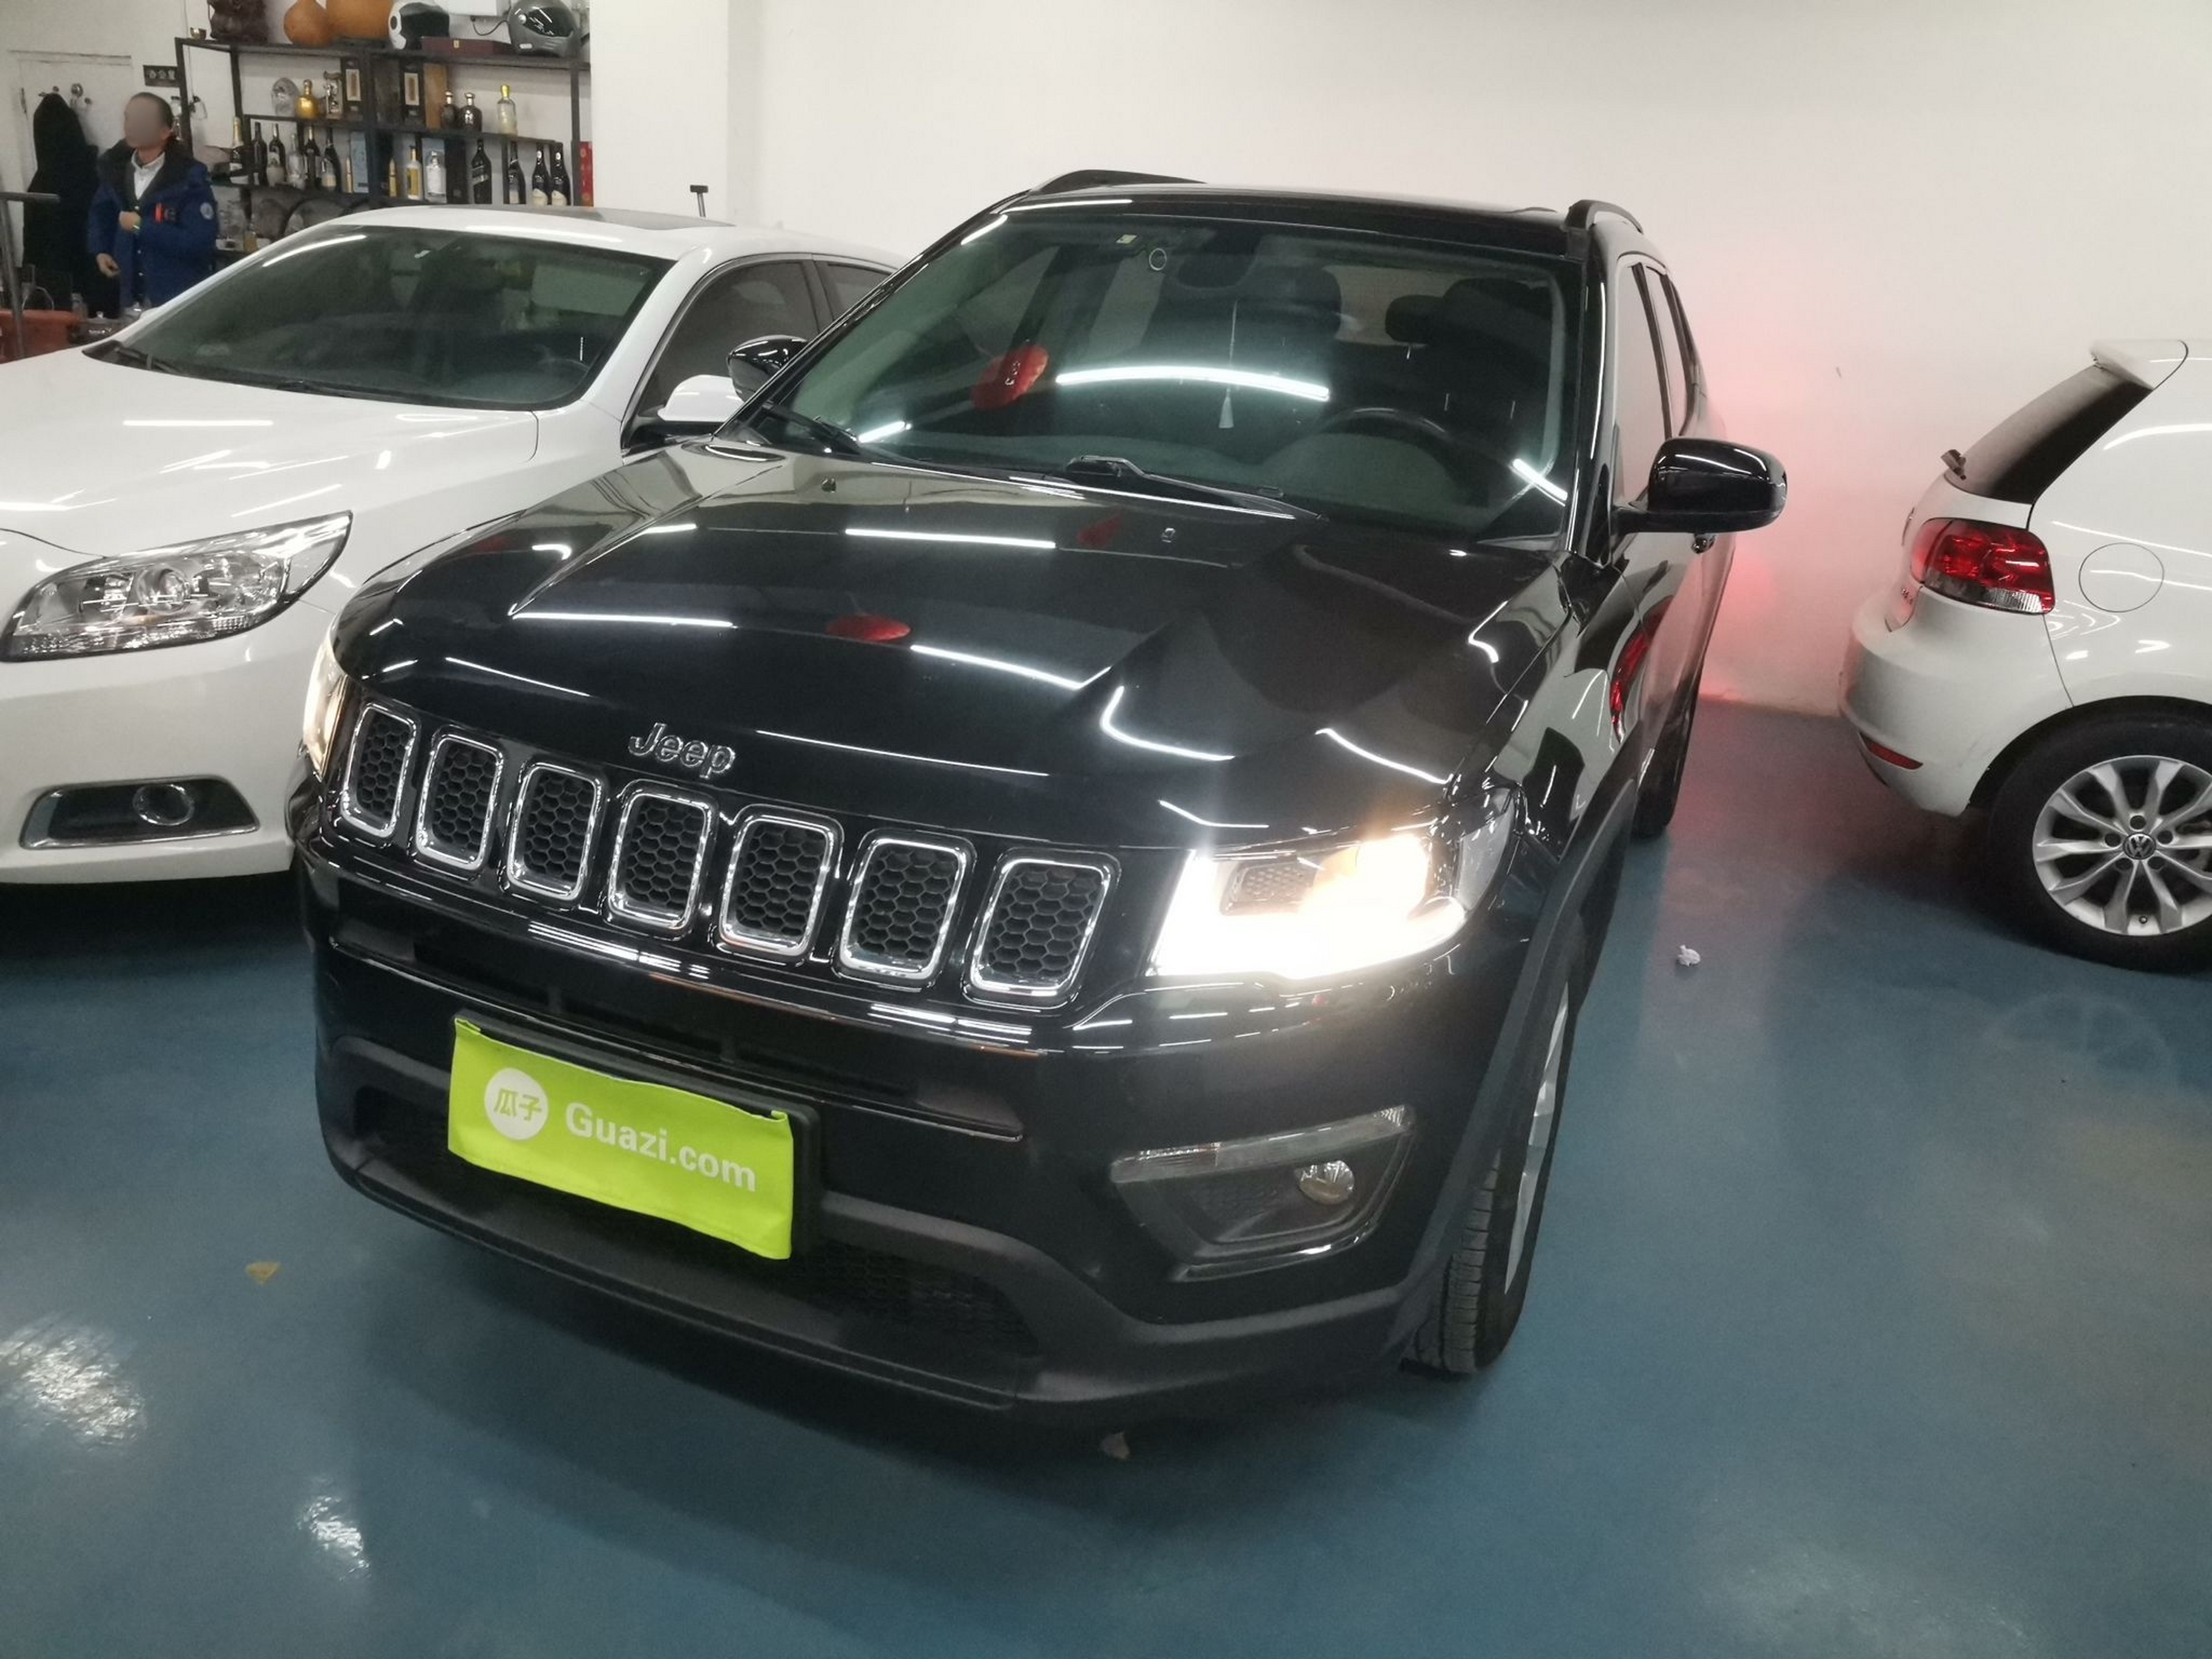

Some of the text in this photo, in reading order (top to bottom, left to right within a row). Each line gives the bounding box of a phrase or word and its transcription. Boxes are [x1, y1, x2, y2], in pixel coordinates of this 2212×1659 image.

[628, 722, 735, 779] Jeep
[493, 1088, 543, 1122] 瓜子
[565, 1103, 756, 1192] Guazi.com
